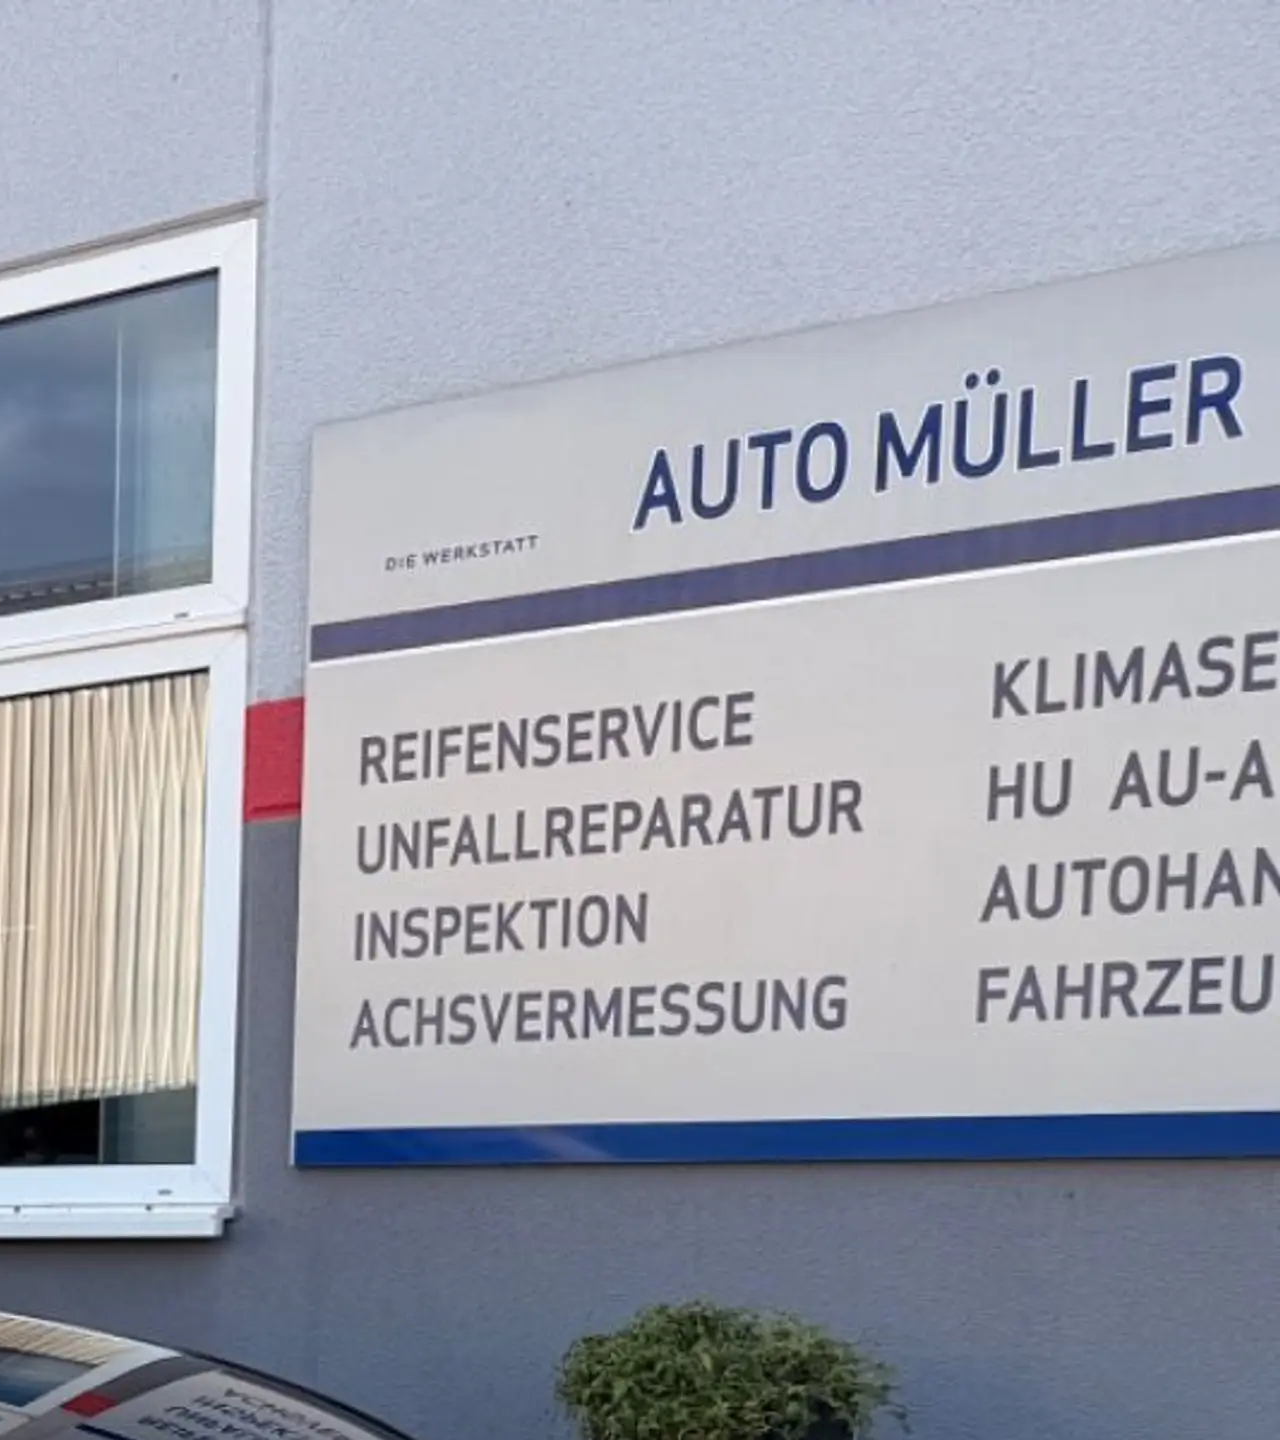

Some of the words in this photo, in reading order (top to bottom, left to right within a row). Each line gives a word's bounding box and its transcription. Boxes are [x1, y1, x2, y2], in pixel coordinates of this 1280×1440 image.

[633, 422, 849, 530] AUTO
[875, 356, 1244, 493] MÜLLER
[385, 553, 418, 571] DIE
[422, 534, 539, 567] WERKSTATT
[992, 630, 1280, 719] KLIMASE
[360, 691, 755, 786] REIFENSERVICE
[987, 758, 1073, 822] HU
[1109, 739, 1274, 811] AU-A
[357, 779, 863, 875] UNFALLREPARATUR
[979, 847, 1280, 923] AUTOHAN
[354, 892, 648, 962] INSPEKTION
[349, 975, 847, 1049] ACHSVERMESSUNG
[976, 953, 1275, 1024] FAHRZEU
